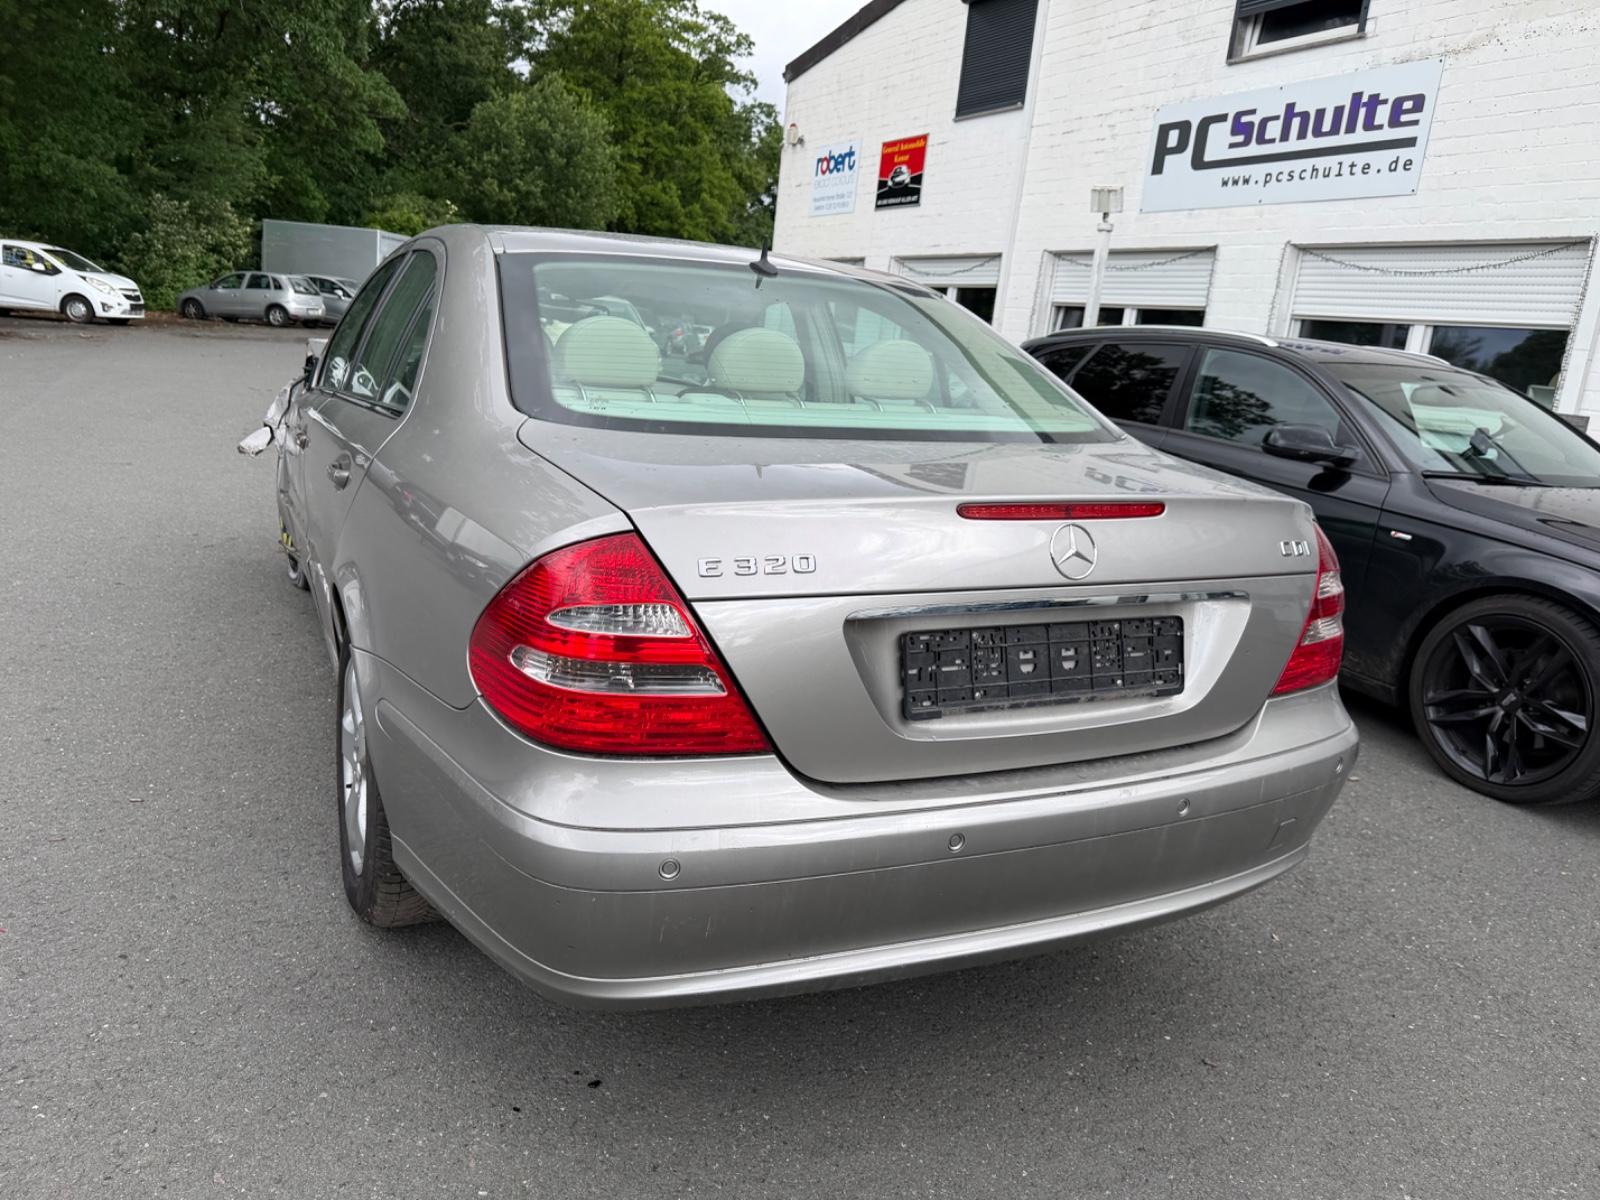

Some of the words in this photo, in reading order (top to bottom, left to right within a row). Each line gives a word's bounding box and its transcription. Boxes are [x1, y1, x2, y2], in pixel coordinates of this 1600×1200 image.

[815, 145, 856, 177] robert
[1220, 156, 1414, 187] www.pcschulte.de
[1280, 540, 1312, 557] CDI
[697, 557, 724, 578] E
[734, 554, 817, 576] 320
